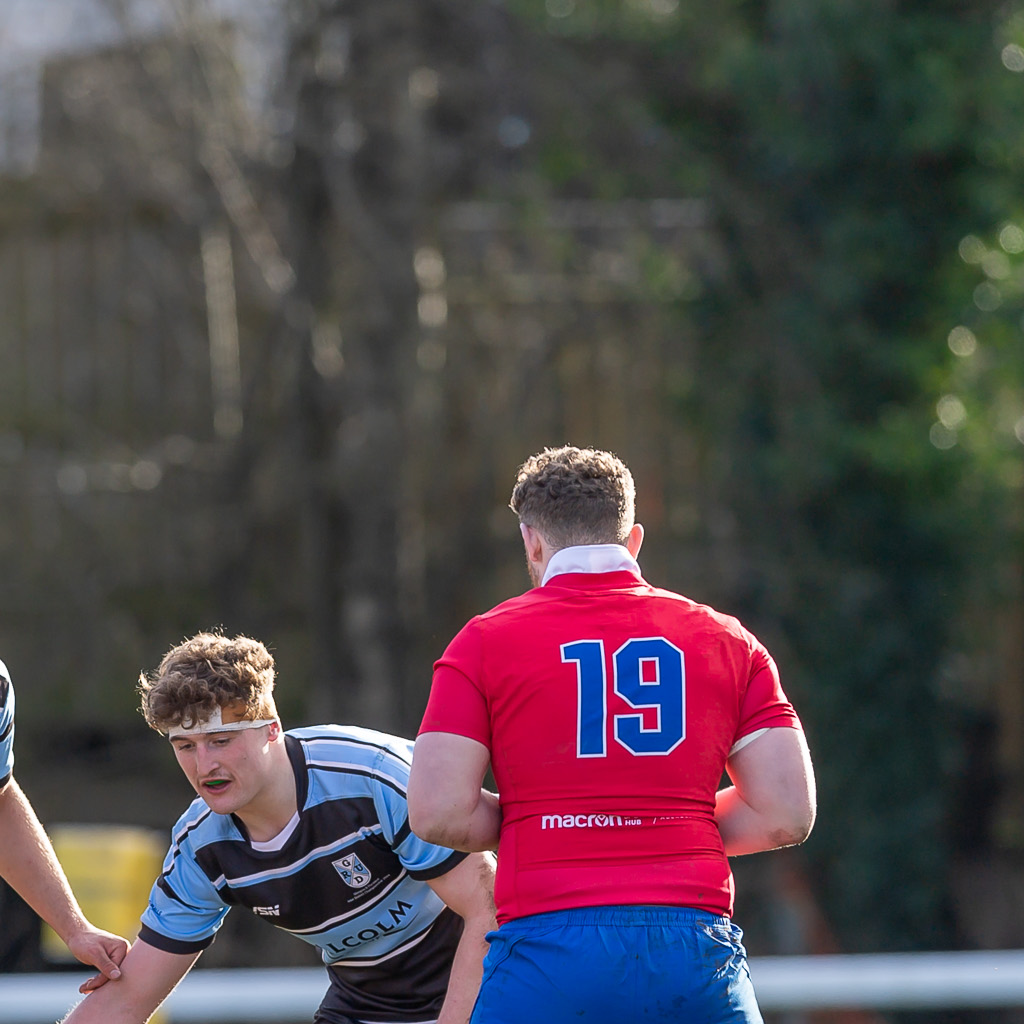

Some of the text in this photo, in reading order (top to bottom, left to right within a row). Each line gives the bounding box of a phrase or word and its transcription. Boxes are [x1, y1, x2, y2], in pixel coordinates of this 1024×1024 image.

[559, 636, 686, 758] 19
[541, 814, 623, 830] macron
[326, 900, 413, 953] LCOLM
